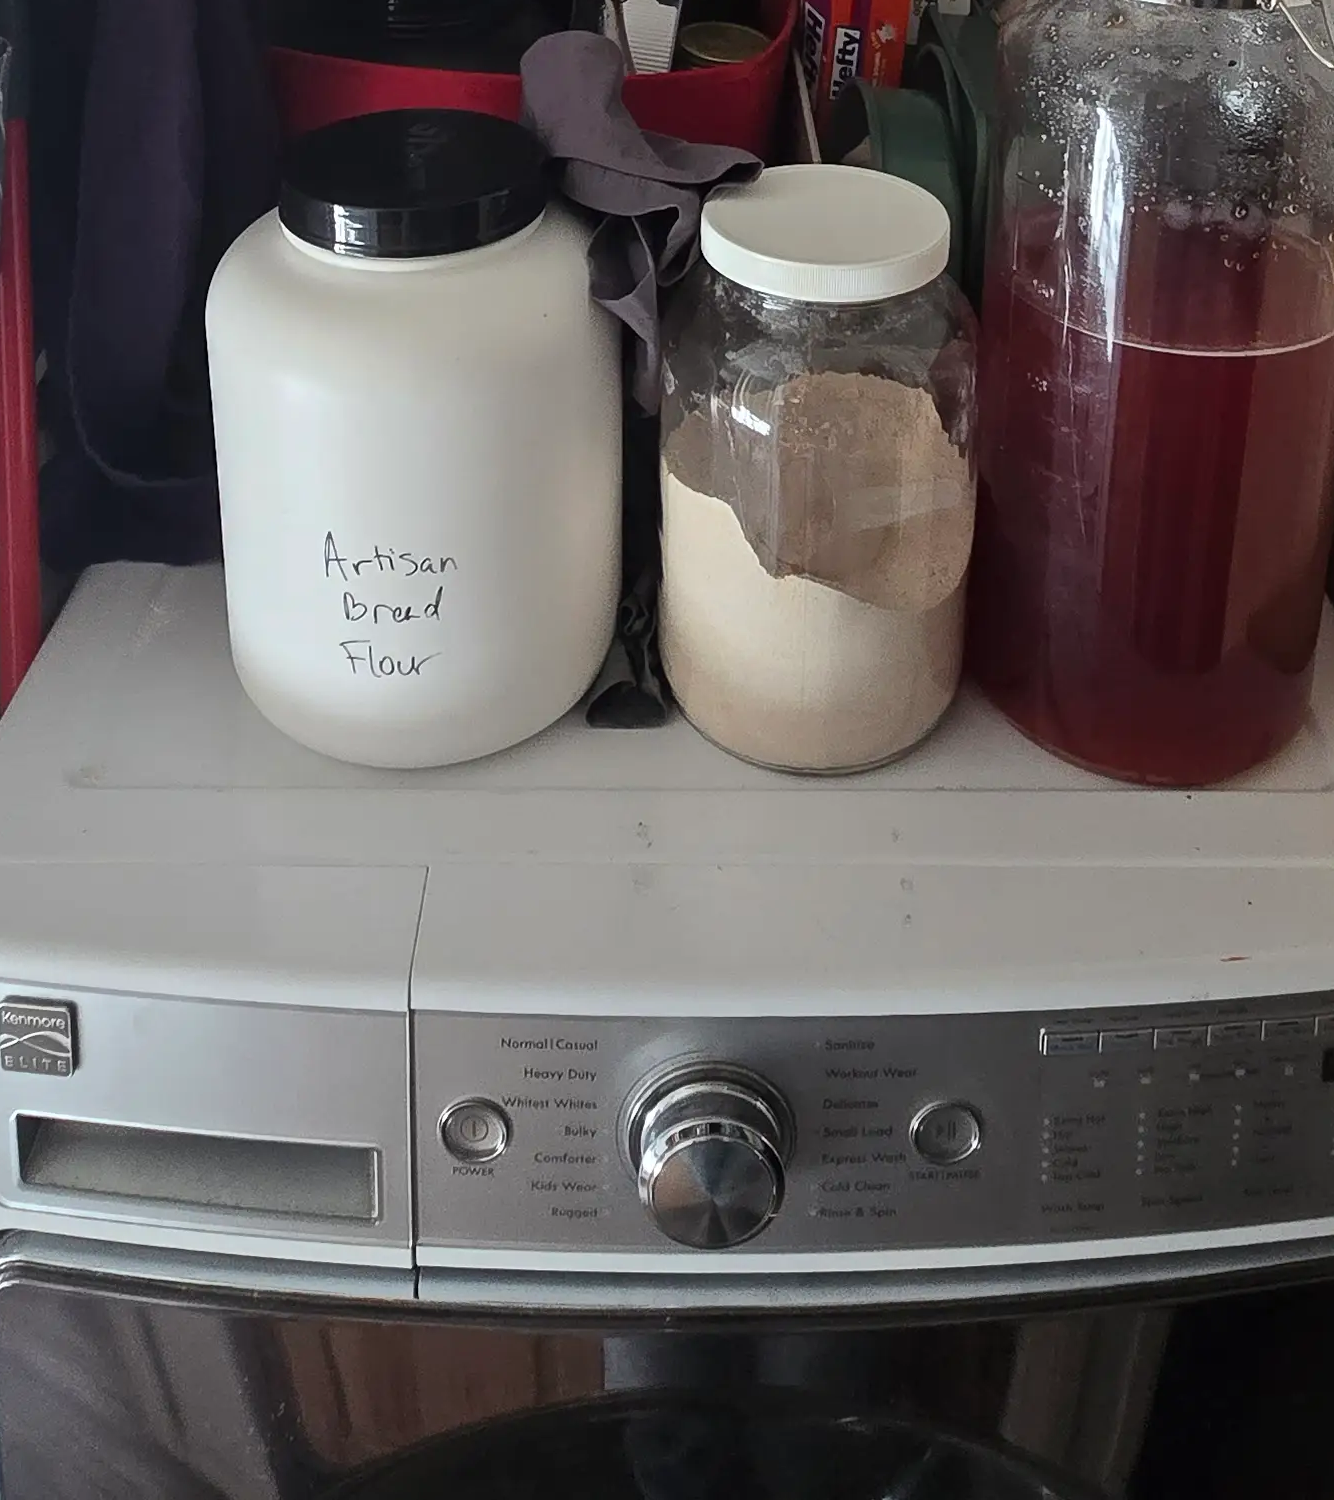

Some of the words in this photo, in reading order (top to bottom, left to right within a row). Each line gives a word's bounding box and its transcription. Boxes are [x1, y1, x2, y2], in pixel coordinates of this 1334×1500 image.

[323, 530, 458, 582] Artisan
[342, 585, 444, 624] Bread
[338, 639, 443, 678] Flour
[1, 1010, 66, 1030] Kenmore
[4, 1055, 67, 1073] ELITE
[523, 1067, 564, 1081] Heavy
[568, 1068, 597, 1082] Duty
[502, 1096, 549, 1108] Whitest
[555, 1097, 597, 1110] Whites
[564, 1125, 597, 1138] Bulky
[534, 1152, 596, 1163] Comforter
[452, 1166, 495, 1177] POWER
[531, 1180, 557, 1192] Kids
[563, 1181, 597, 1192] Wear
[551, 1206, 598, 1219] Rugged
[869, 1206, 897, 1219] Spin
